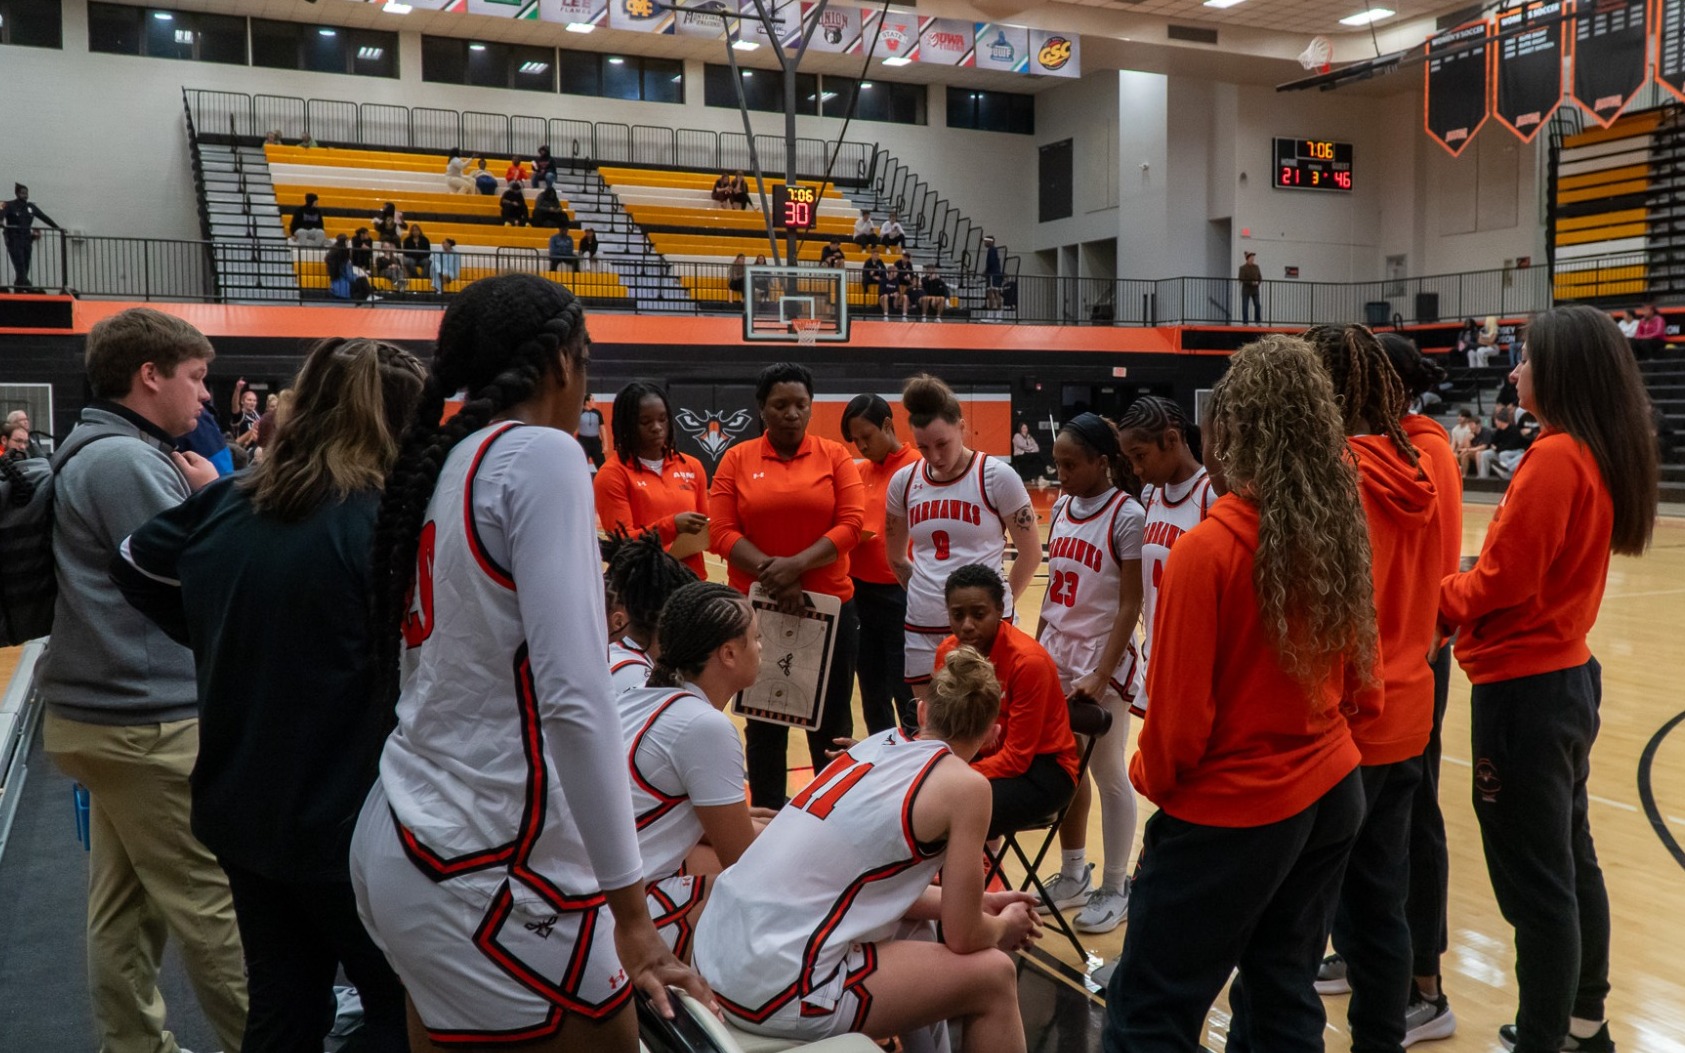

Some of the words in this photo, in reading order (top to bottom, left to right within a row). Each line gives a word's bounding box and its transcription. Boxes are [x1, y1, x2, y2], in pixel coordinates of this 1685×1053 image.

[1533, 3, 1560, 18] SOCCER
[1038, 41, 1072, 66] GSC
[1306, 140, 1334, 159] 7:06
[1281, 167, 1300, 185] 21
[1312, 170, 1320, 185] 3
[1333, 171, 1351, 189] 46
[787, 187, 814, 203] 7:06
[784, 201, 809, 225] 30
[1050, 569, 1079, 608] 23
[789, 751, 875, 821] 11
